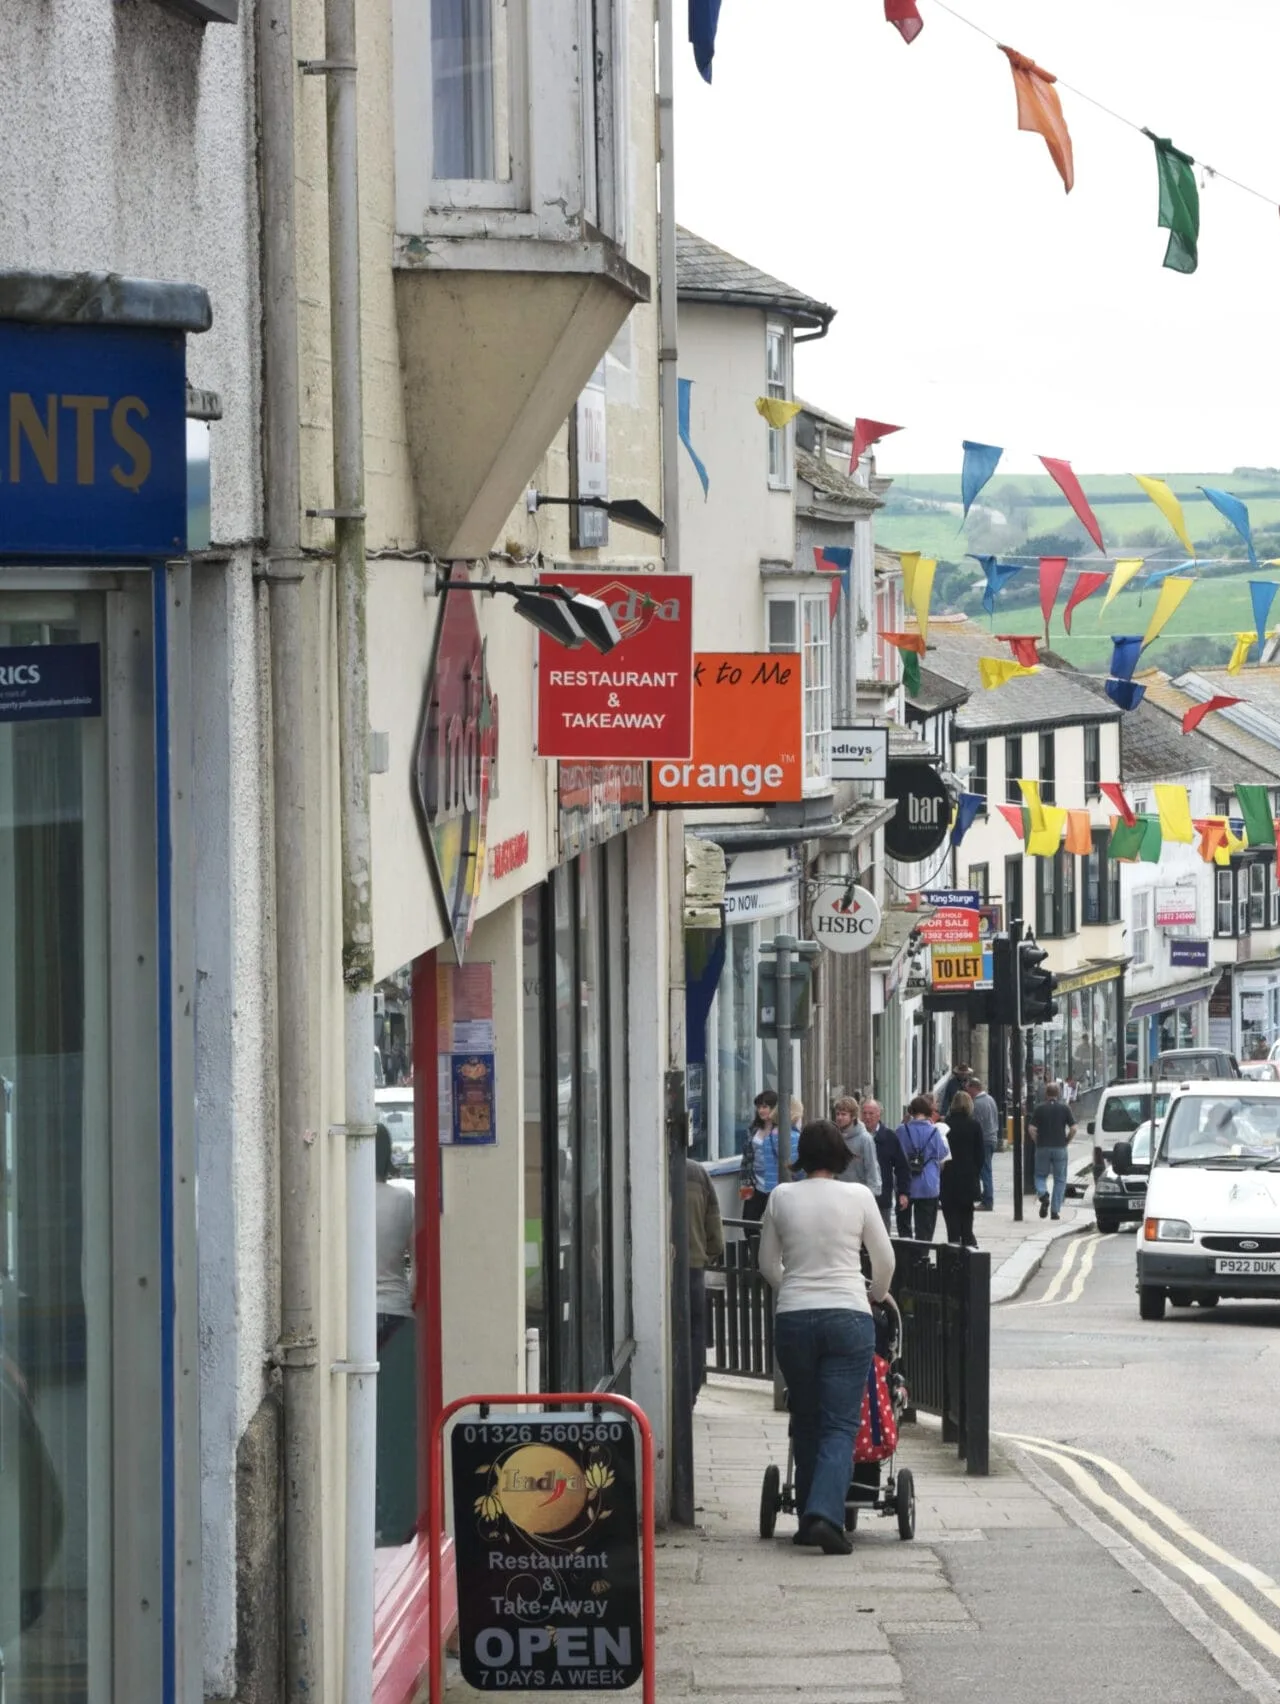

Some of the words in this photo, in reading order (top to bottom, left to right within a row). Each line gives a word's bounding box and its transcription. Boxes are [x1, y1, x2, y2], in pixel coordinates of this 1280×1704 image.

[0, 391, 152, 492] NTS
[550, 671, 678, 688] RESTAURANT
[715, 662, 742, 685] to
[752, 662, 792, 685] Me
[607, 692, 621, 708] &
[562, 713, 666, 729] TAKEAWAY
[658, 762, 784, 796] orange
[908, 792, 943, 824] bar
[818, 915, 874, 935] HSBC
[945, 918, 970, 927] SALE
[935, 958, 953, 978] TO
[955, 957, 980, 977] LET
[1220, 1260, 1250, 1272] P922
[1253, 1261, 1276, 1272] DUK
[464, 1425, 532, 1444] 01326
[540, 1424, 621, 1443] 560560
[489, 1551, 608, 1570] Restaurant
[543, 1576, 556, 1591] &
[491, 1597, 607, 1618] Take-Away
[475, 1627, 632, 1668] OPEN
[480, 1670, 488, 1685] 7
[496, 1670, 545, 1685] DAYS
[551, 1669, 564, 1684] A
[567, 1669, 625, 1685] WEEK
